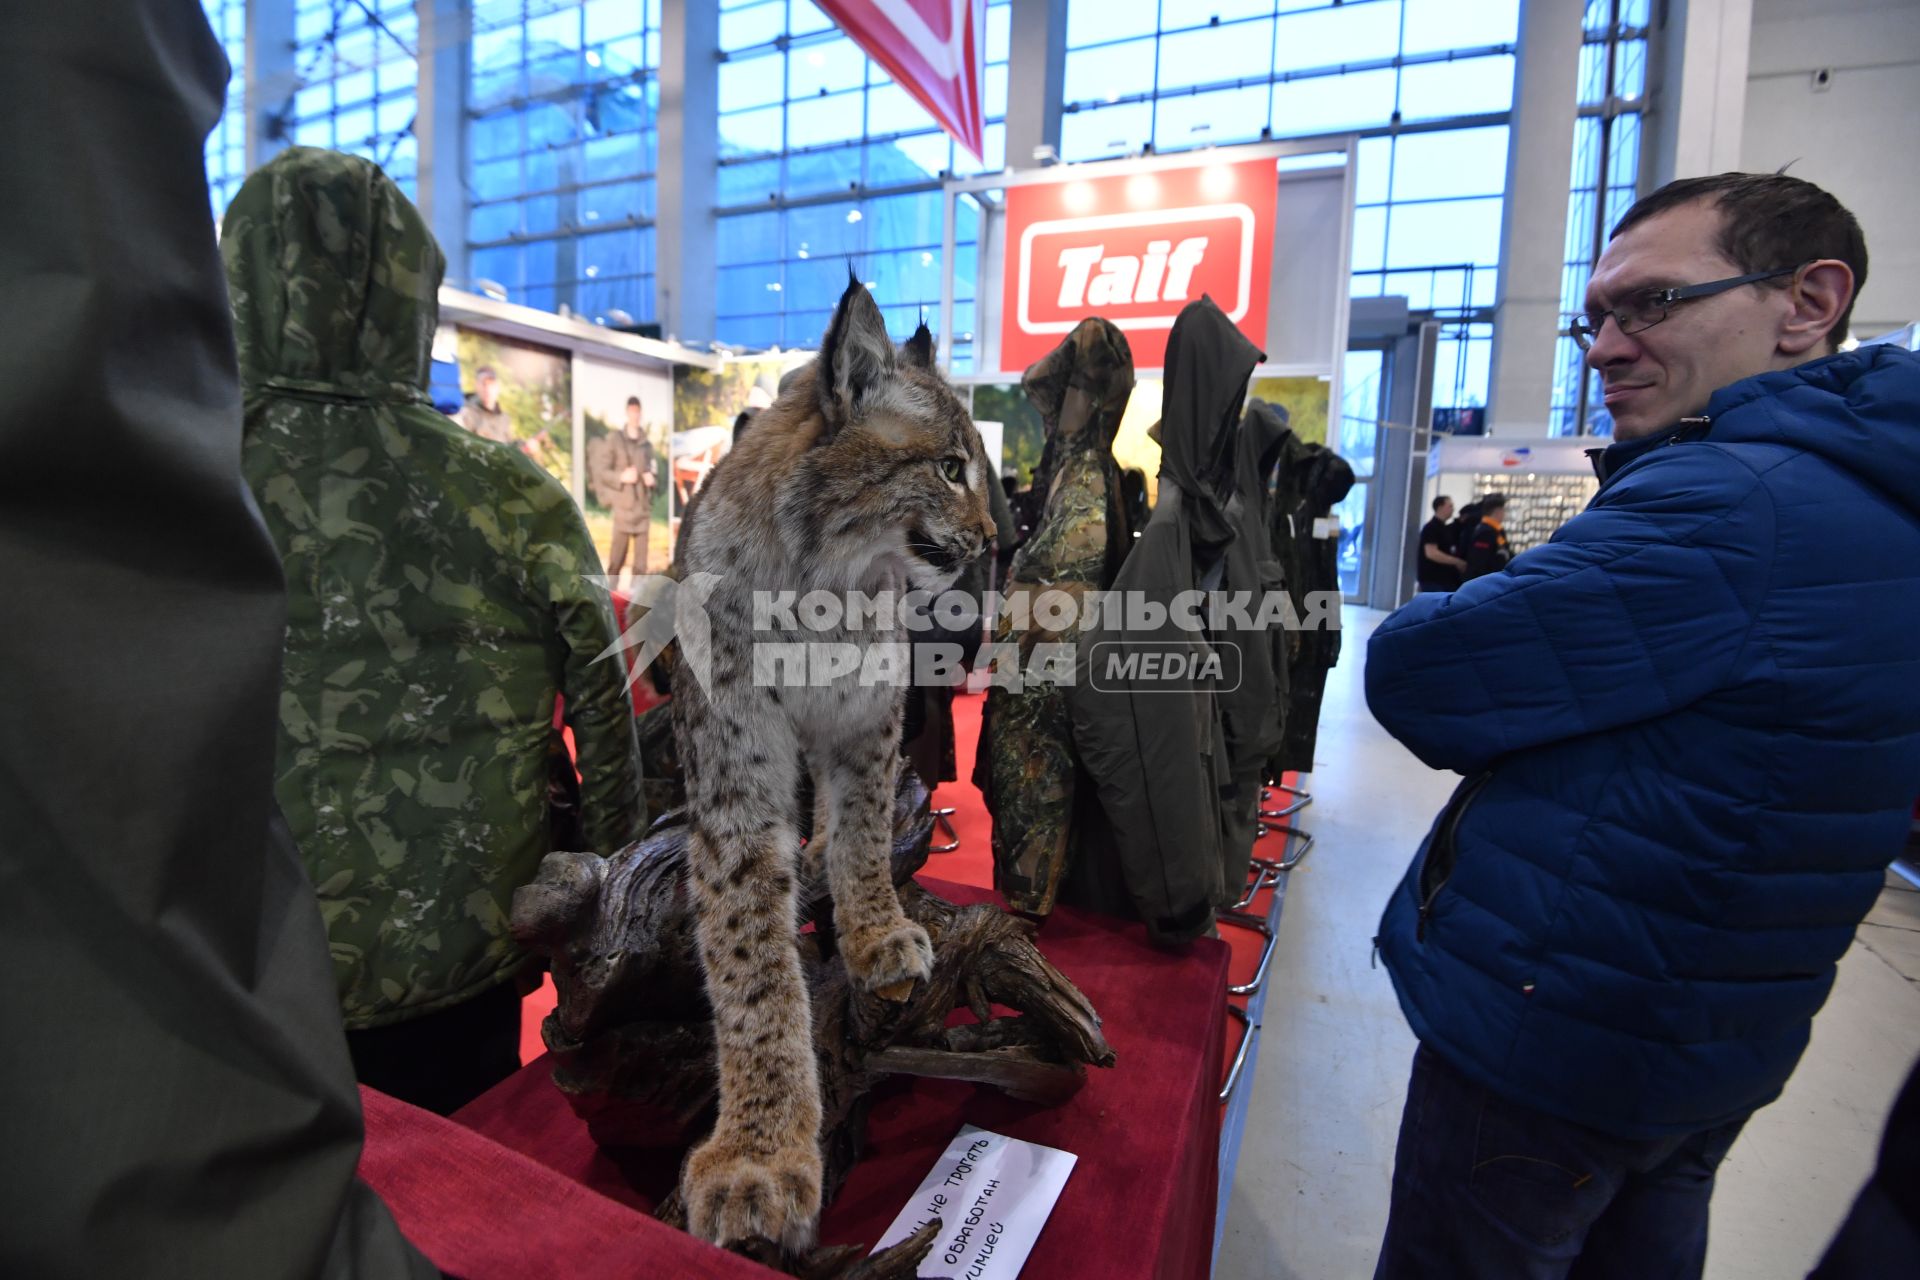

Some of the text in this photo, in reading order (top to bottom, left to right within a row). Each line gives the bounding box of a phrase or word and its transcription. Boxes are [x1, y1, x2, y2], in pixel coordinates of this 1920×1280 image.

[1057, 236, 1209, 308] Taif
[945, 1139, 989, 1186] ТРОГАТЬ
[945, 1179, 1000, 1264] ОБРАБОТАН
